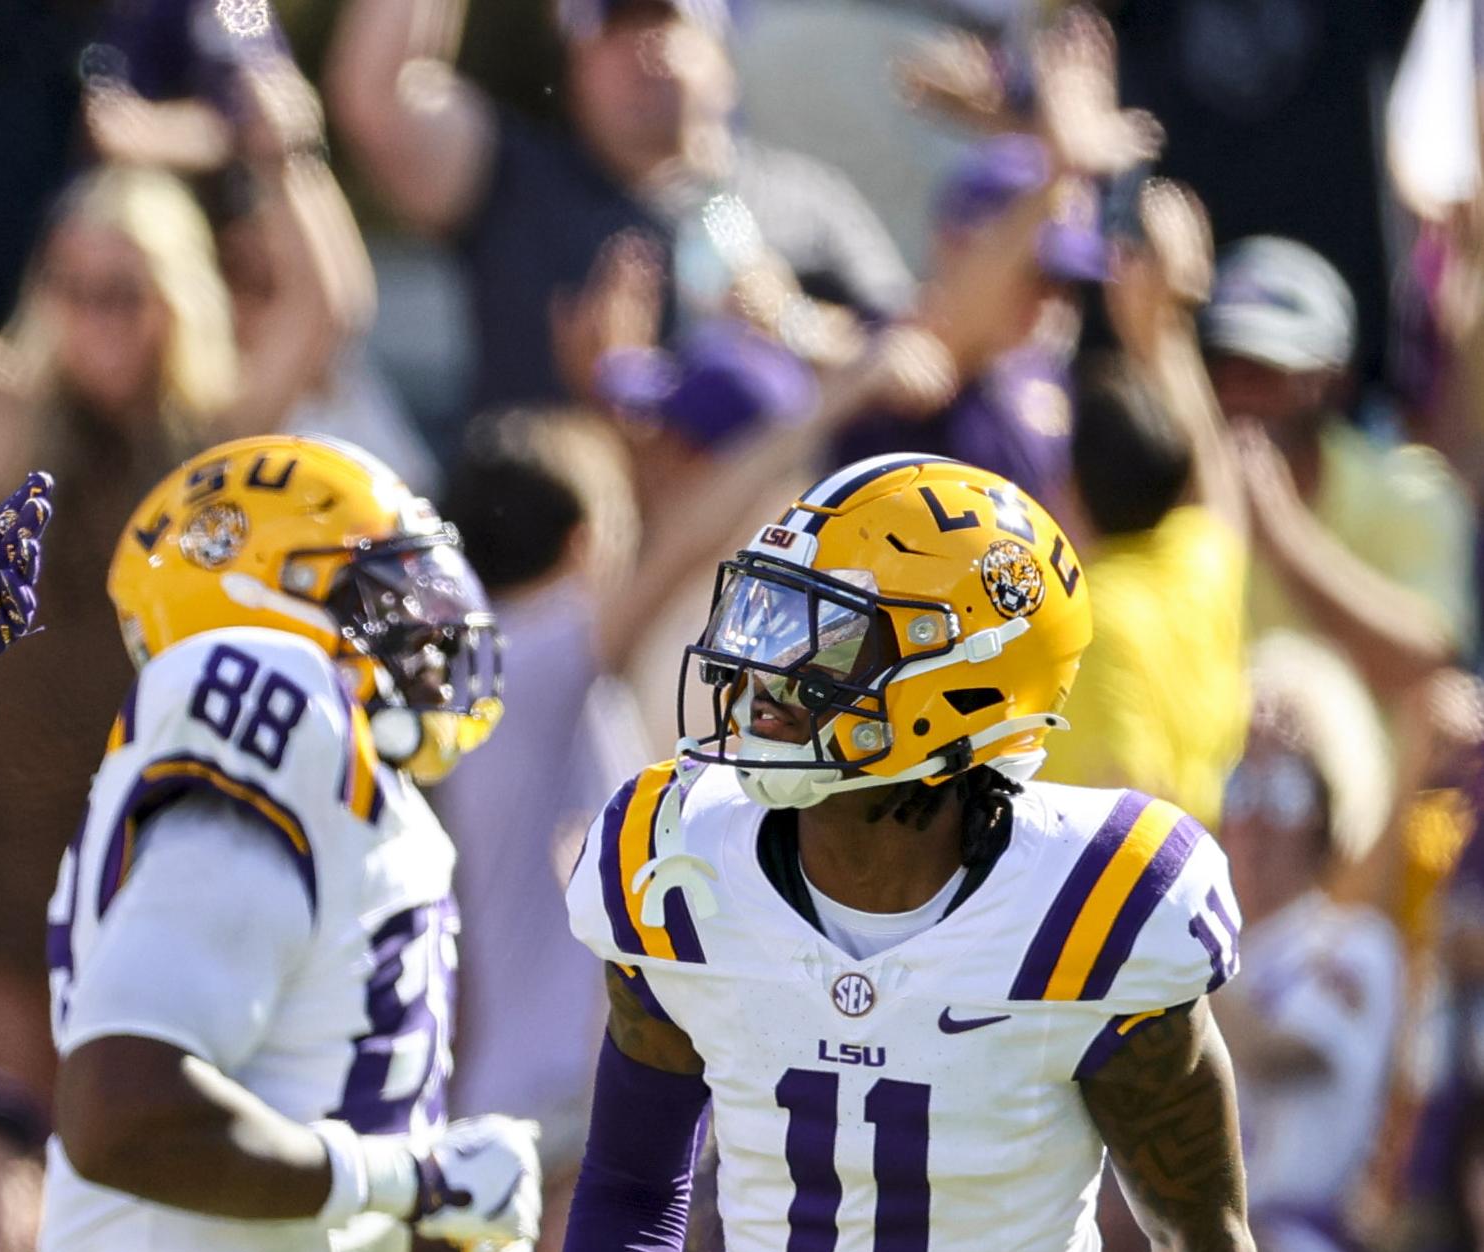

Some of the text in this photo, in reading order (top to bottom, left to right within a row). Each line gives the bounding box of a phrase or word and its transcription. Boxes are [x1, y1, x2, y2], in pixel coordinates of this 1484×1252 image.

[760, 527, 798, 549] LSU
[189, 644, 307, 769] 88
[835, 975, 873, 1015] SEC
[818, 1039, 886, 1067] LSU
